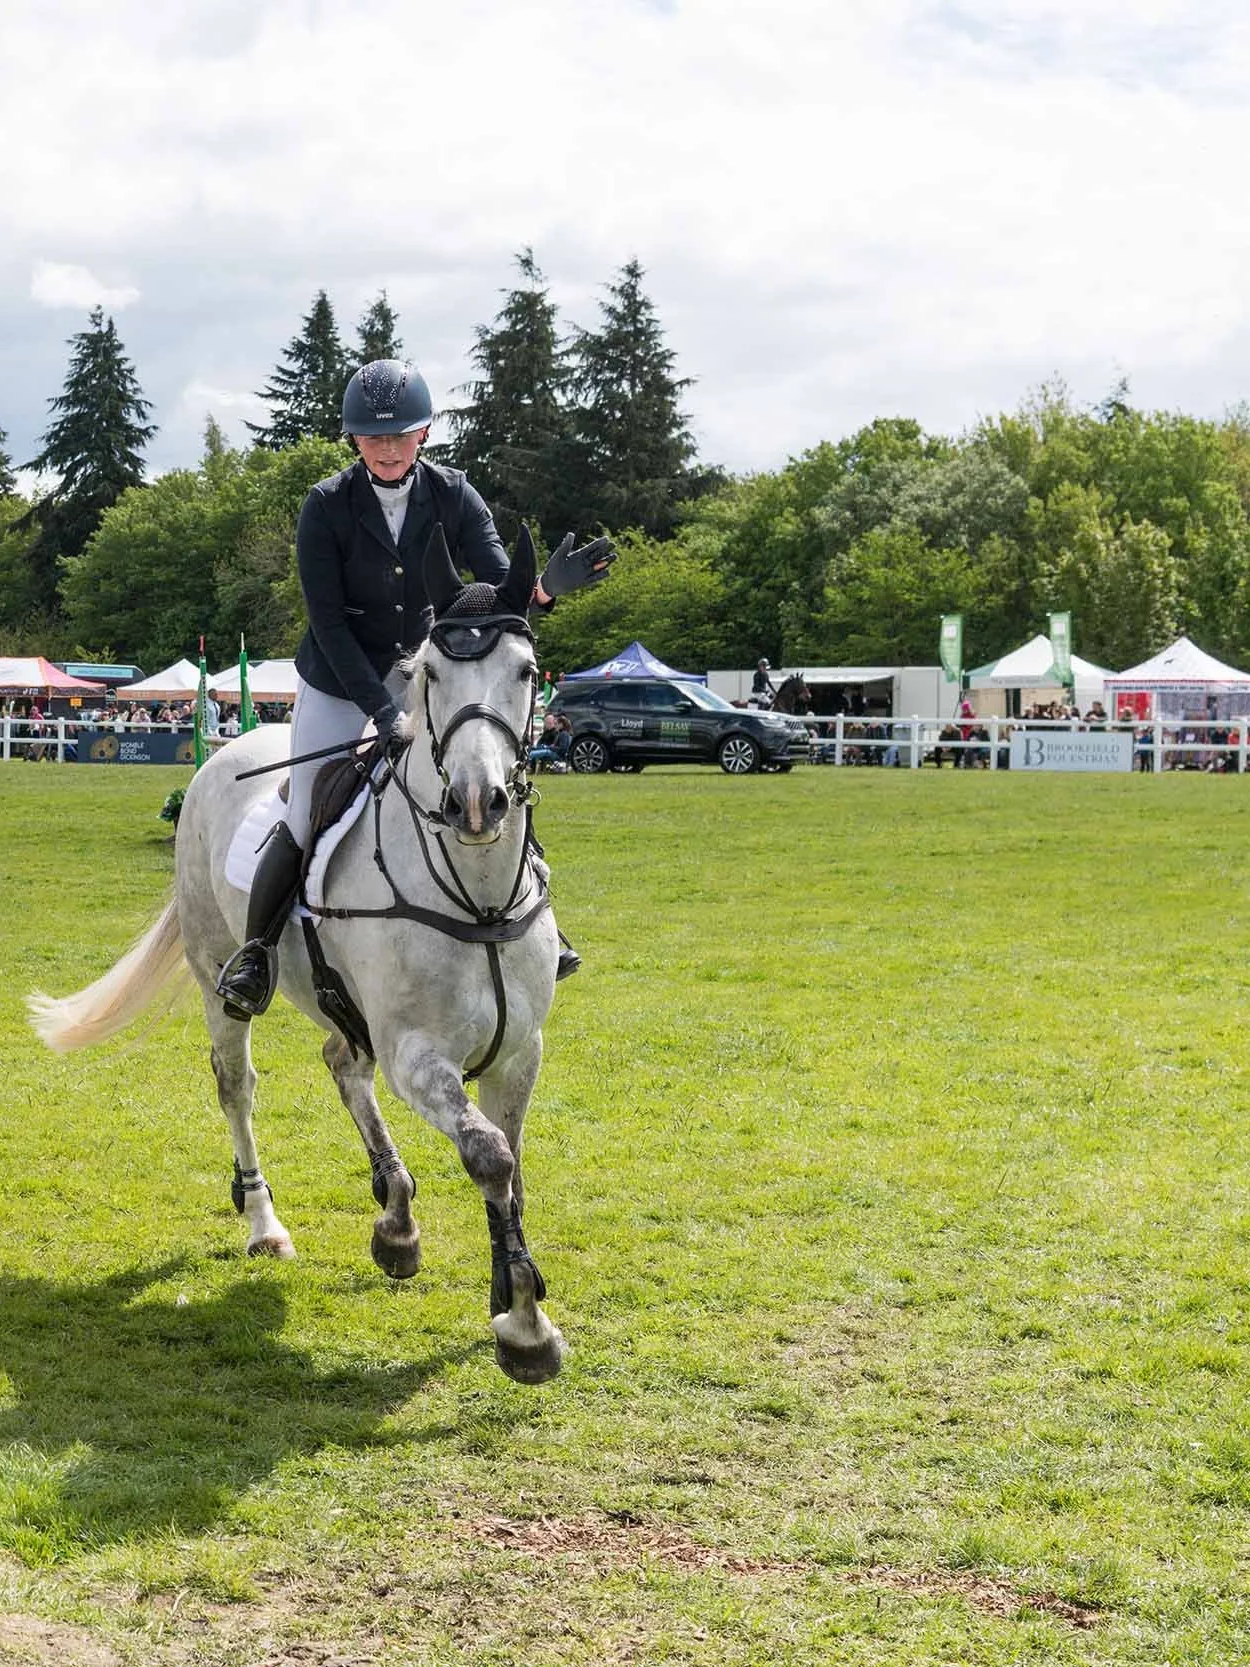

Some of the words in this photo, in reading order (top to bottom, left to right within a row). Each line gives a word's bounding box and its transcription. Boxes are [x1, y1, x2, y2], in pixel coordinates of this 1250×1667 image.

[621, 718, 643, 729] Lloyd
[1047, 743, 1120, 752] BROOKFIELD
[1047, 753, 1118, 763] EQUESTRIAN
